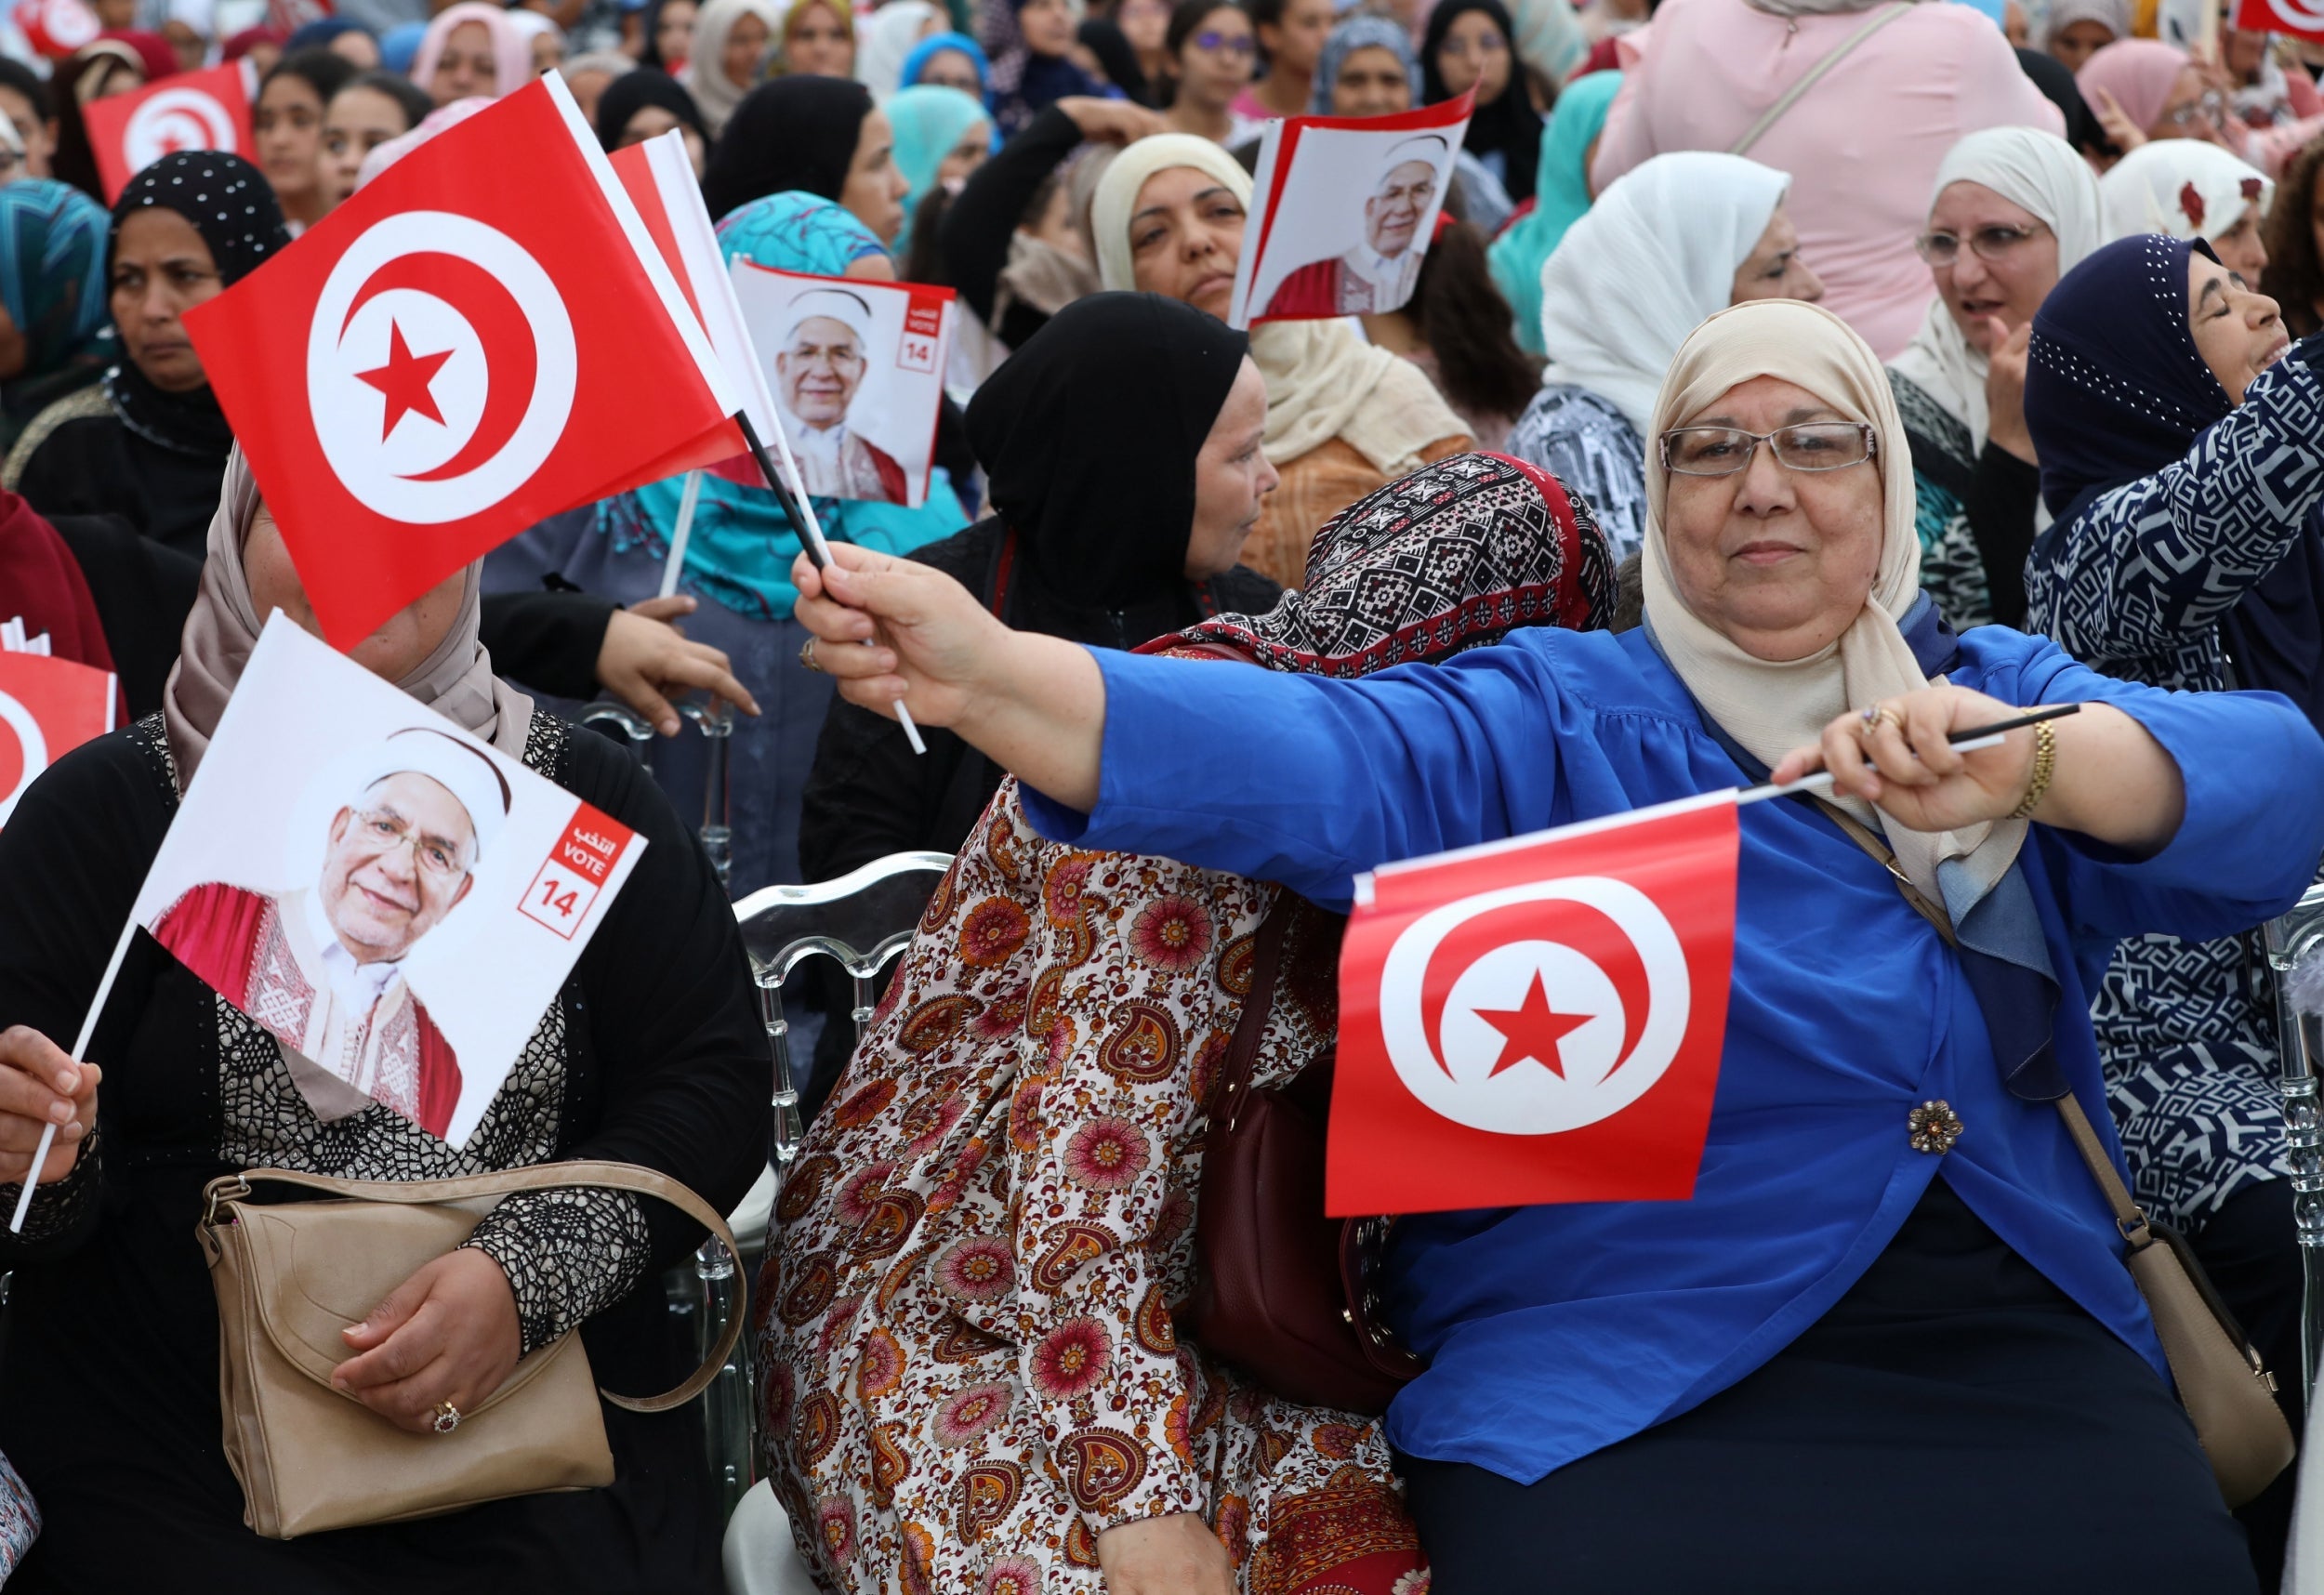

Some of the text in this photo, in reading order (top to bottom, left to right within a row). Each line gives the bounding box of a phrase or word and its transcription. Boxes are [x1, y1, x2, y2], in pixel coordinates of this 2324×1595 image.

[907, 343, 928, 362] 14
[563, 841, 606, 877] VOTE
[542, 880, 578, 917] 14
